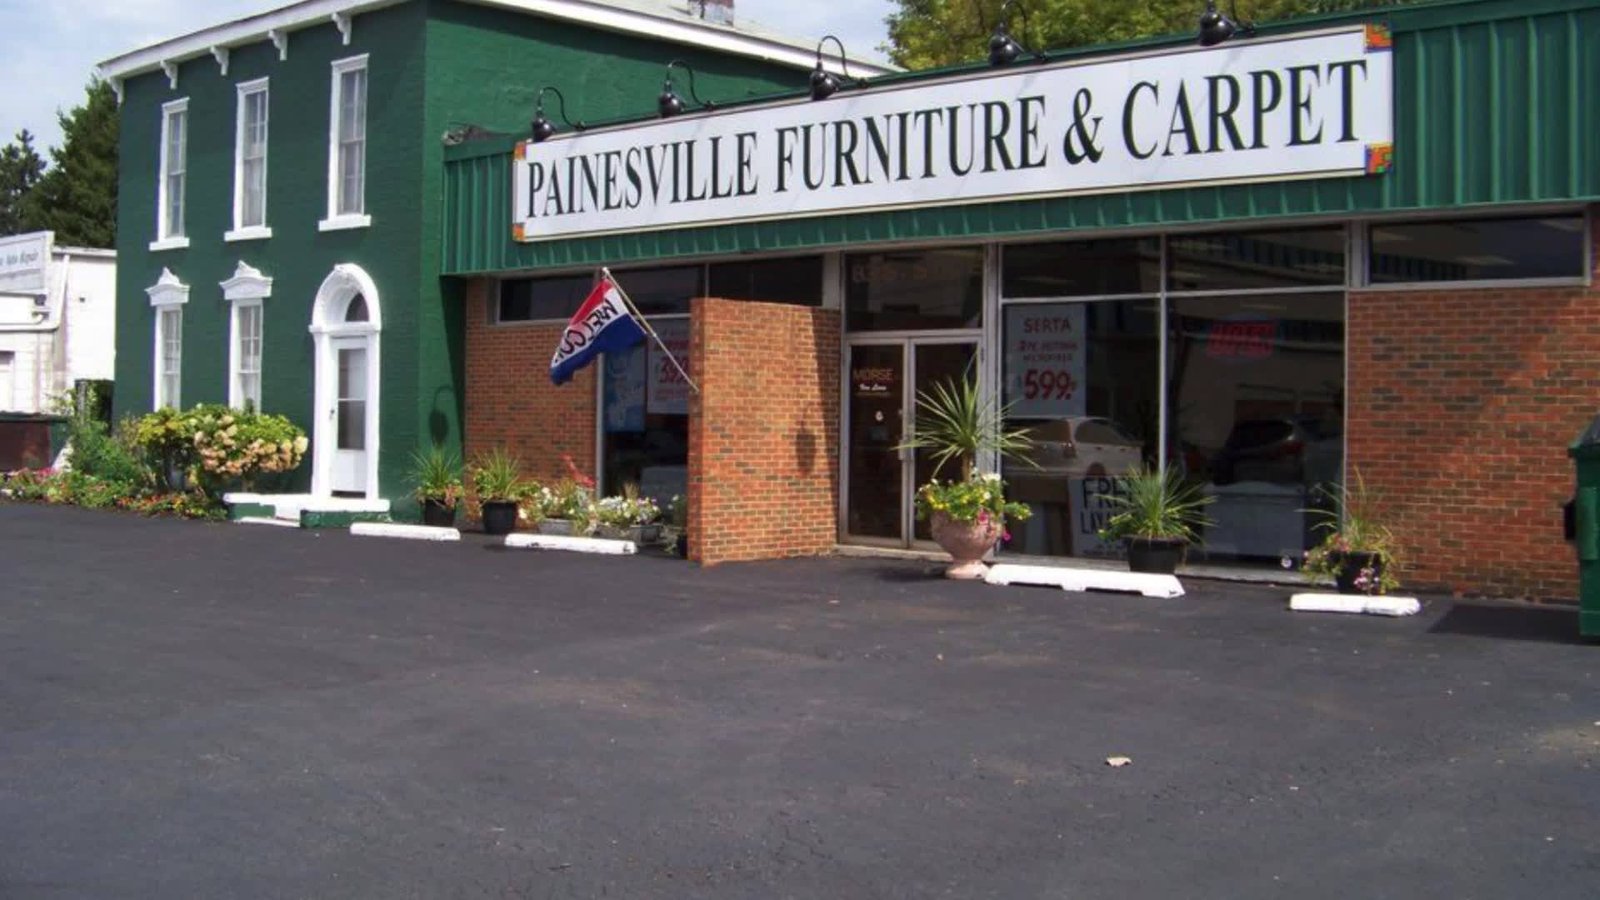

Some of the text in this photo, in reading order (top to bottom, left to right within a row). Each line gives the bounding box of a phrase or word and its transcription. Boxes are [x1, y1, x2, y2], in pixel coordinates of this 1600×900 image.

[527, 59, 1368, 218] PAINESVILLE FURNITURE & CARPET
[1023, 318, 1073, 334] SERTA
[1082, 477, 1134, 509] FRE
